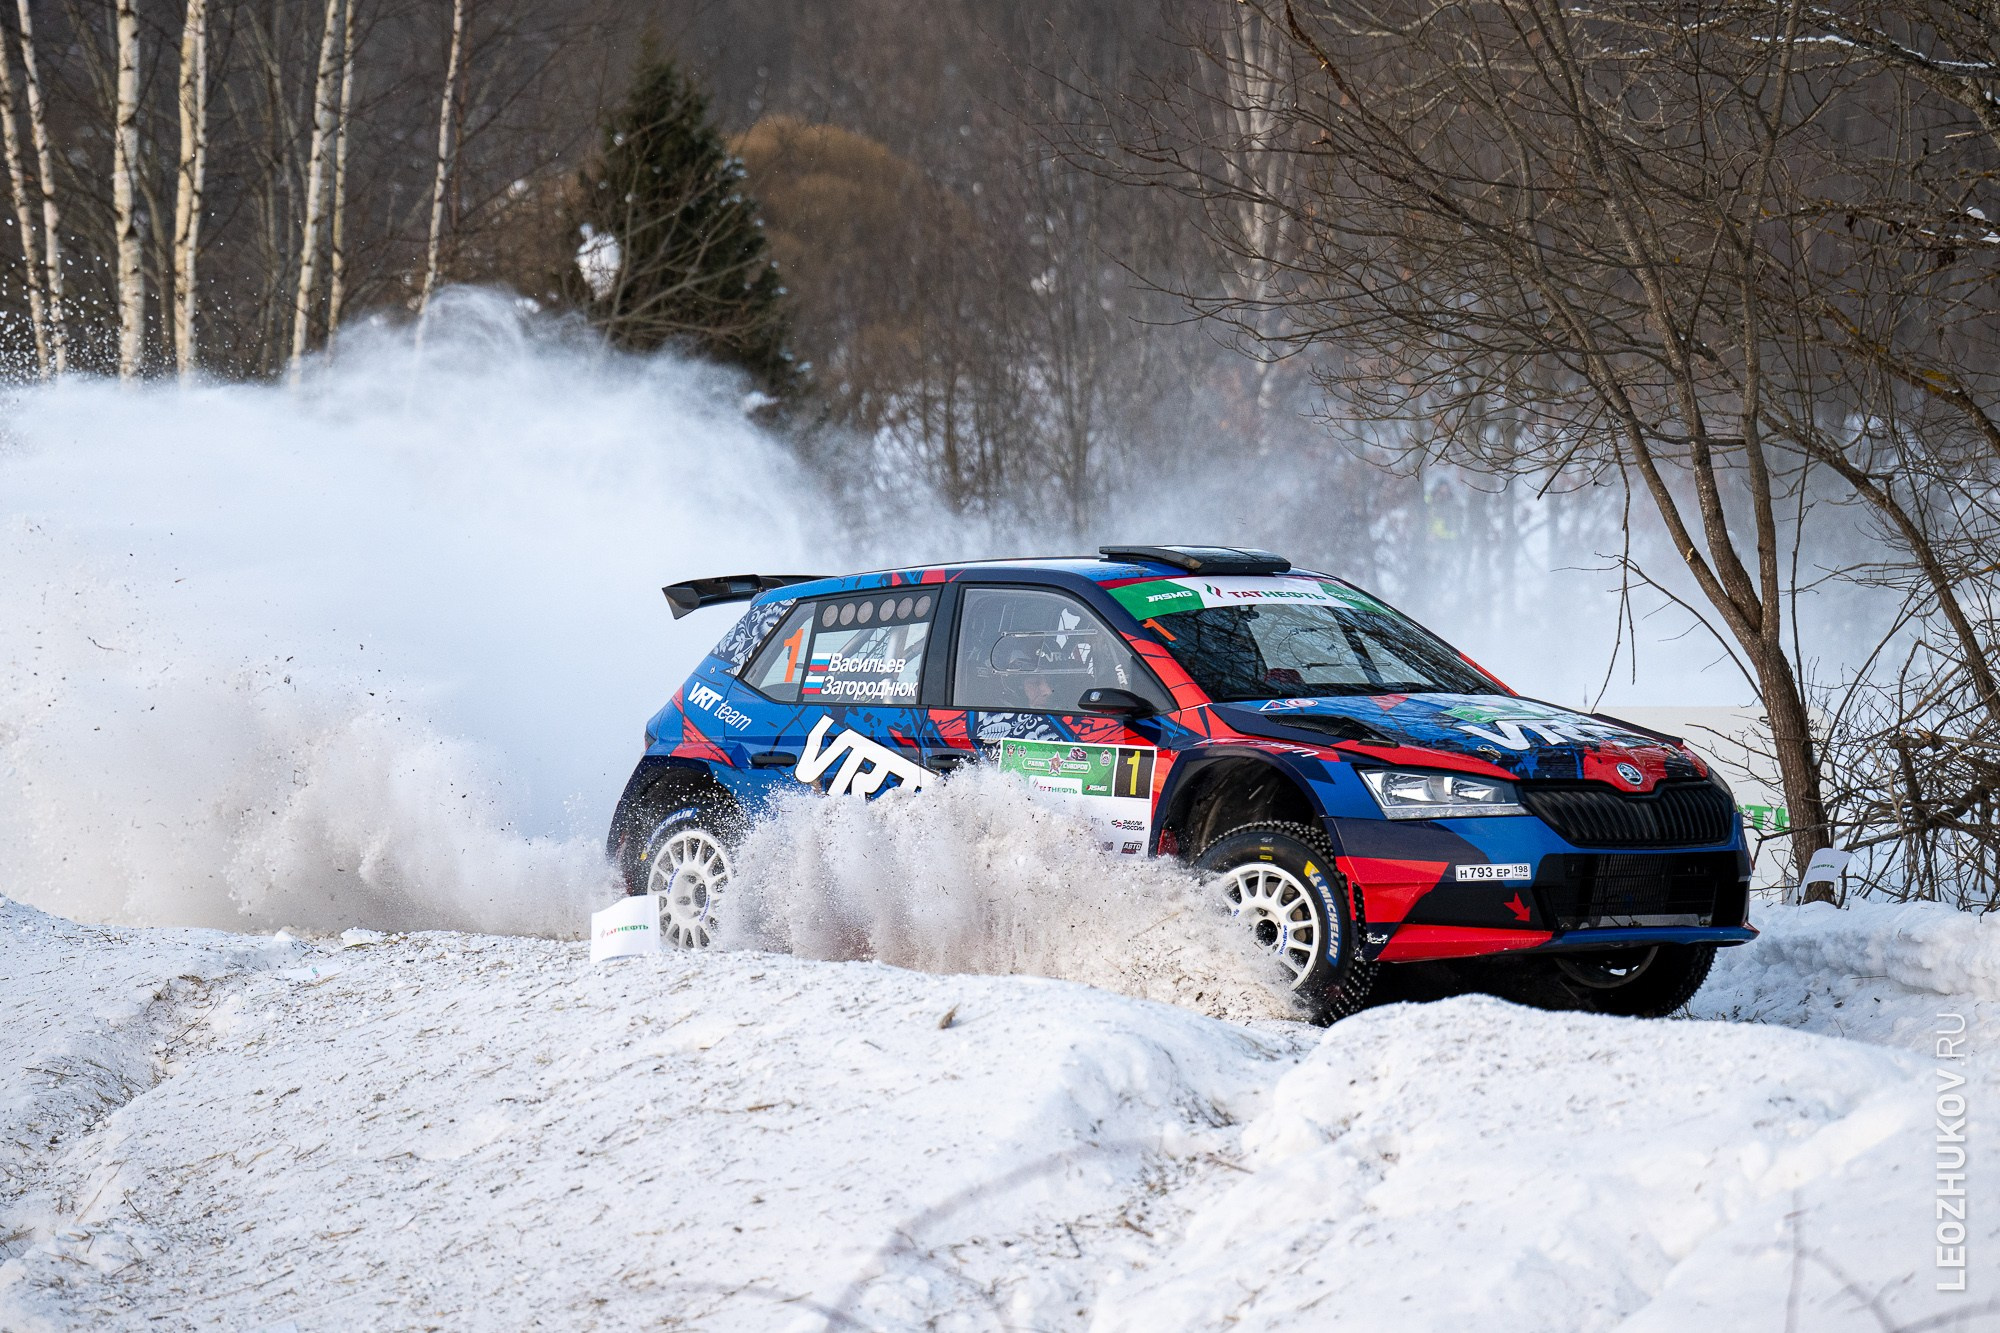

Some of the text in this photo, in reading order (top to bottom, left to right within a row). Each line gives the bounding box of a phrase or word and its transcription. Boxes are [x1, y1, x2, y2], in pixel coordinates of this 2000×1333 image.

[1227, 590, 1327, 600] ТАТНЕФТЬ
[1142, 618, 1177, 642] 1
[783, 628, 804, 683] 1
[828, 653, 906, 673] Васильев
[687, 681, 752, 731] VRT team
[821, 676, 918, 701] Загороднюк
[1127, 750, 1141, 796] 1
[1320, 885, 1339, 959] MICHELIN
